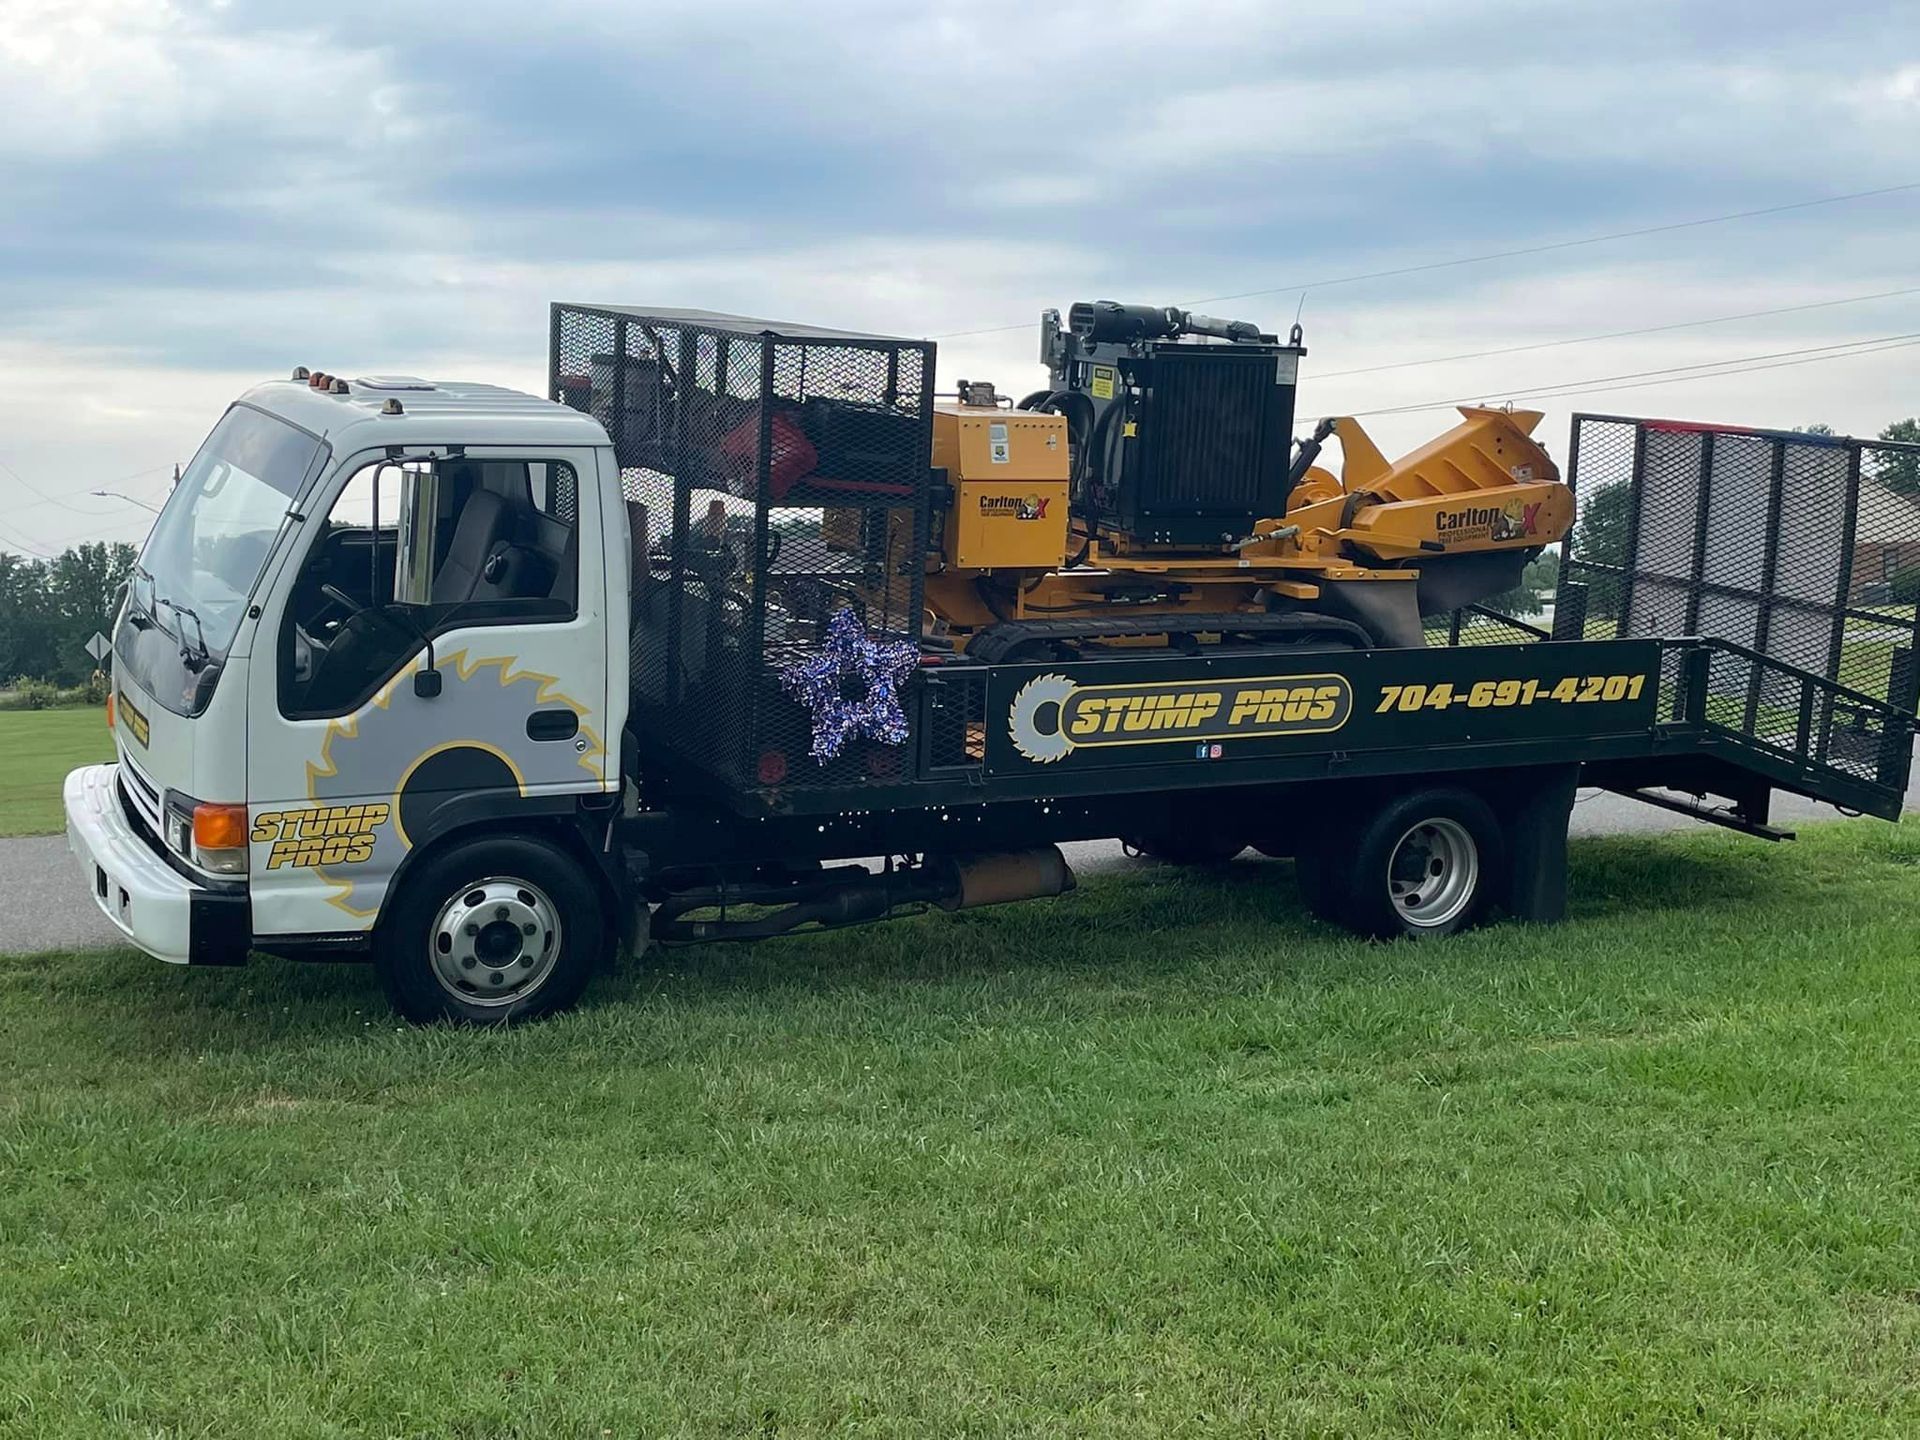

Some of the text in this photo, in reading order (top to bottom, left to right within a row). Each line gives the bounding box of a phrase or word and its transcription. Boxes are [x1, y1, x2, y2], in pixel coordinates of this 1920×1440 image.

[980, 496, 1022, 509] Carlton
[1436, 507, 1500, 530] Carlton
[1071, 686, 1341, 735] STUMP PROS
[1375, 674, 1645, 713] 704-691-4201
[251, 803, 390, 842] STUMP
[266, 833, 376, 870] PROS
